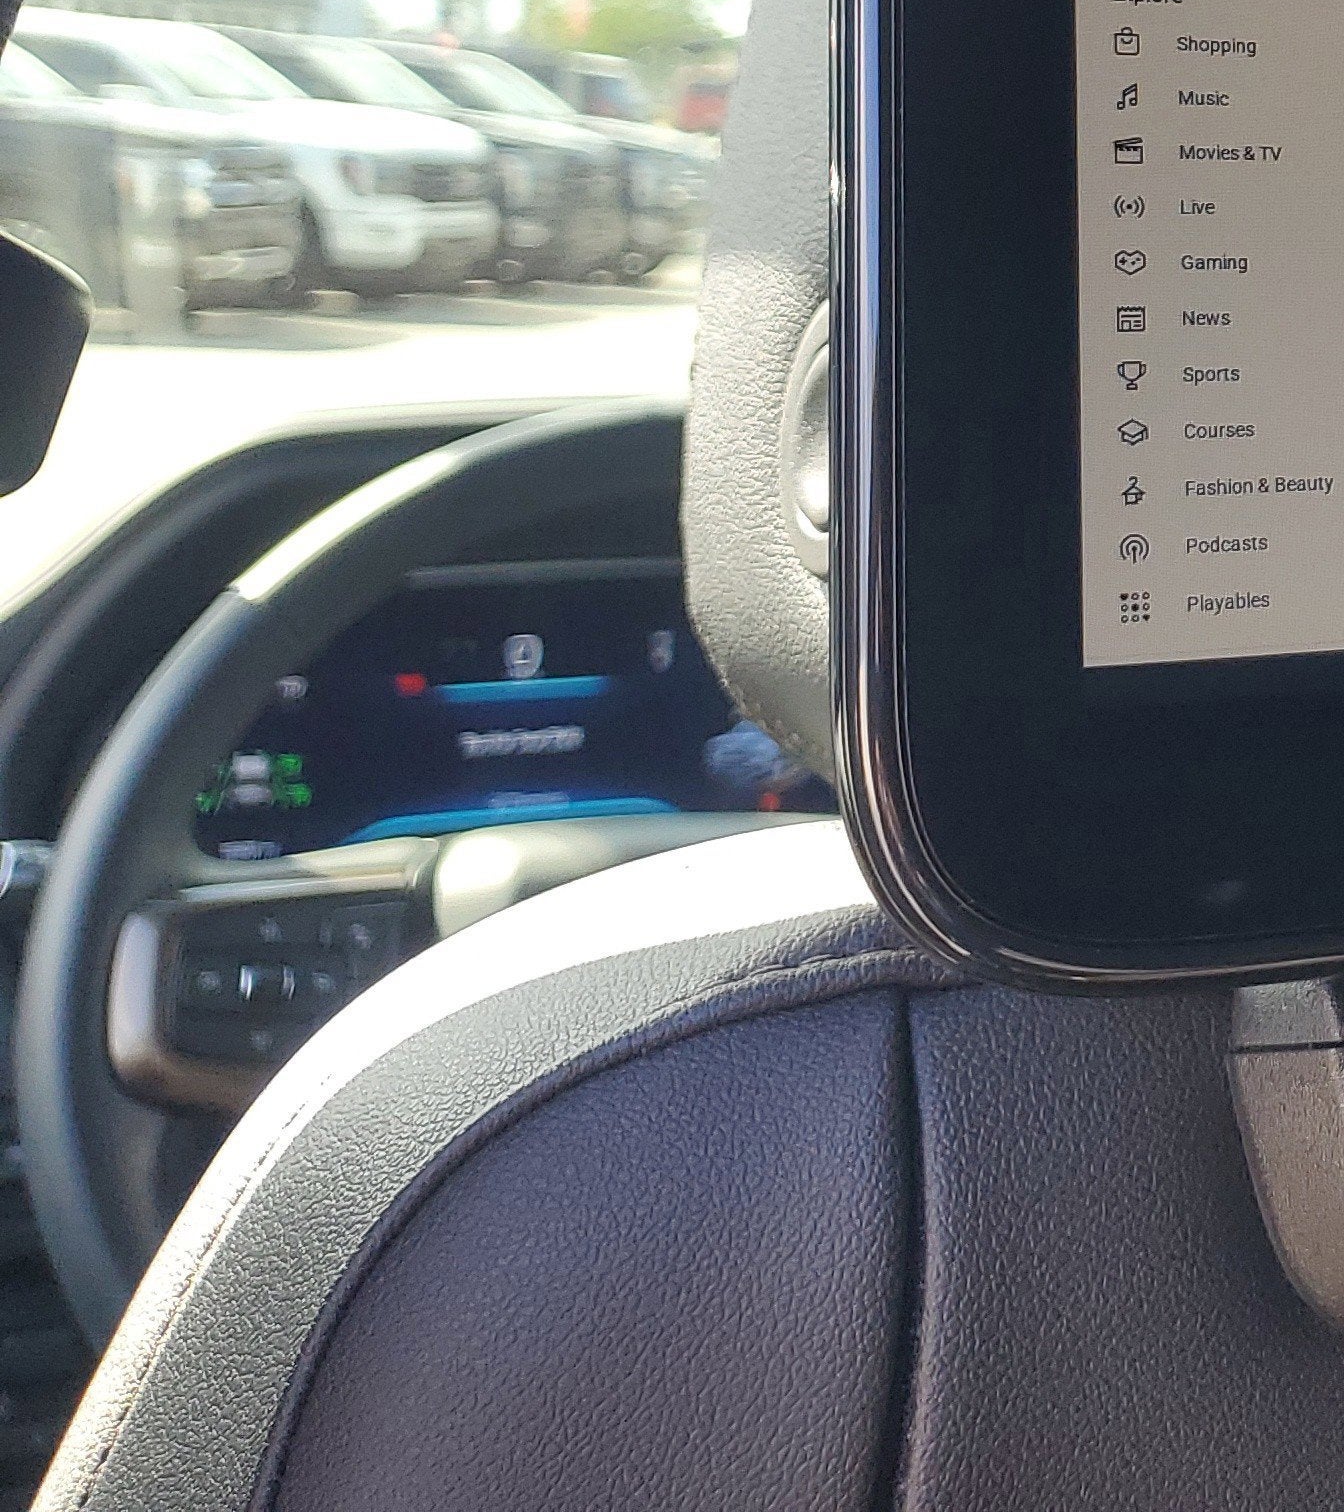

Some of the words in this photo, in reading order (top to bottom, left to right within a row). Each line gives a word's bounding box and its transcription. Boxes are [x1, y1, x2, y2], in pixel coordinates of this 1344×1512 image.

[1176, 35, 1257, 57] Shopping
[1178, 89, 1230, 107] Music
[1179, 144, 1239, 162] Movies
[1243, 145, 1256, 161] &
[1259, 146, 1283, 162] TV
[1179, 199, 1216, 216] Live
[1181, 253, 1249, 274] Gaming
[1182, 310, 1232, 327] News
[1182, 366, 1241, 385] Sports
[1184, 422, 1256, 439] Courses
[1185, 477, 1254, 497] Fashion
[1257, 477, 1270, 493] &
[1275, 475, 1334, 494] Beauty
[1186, 535, 1269, 555] Podcasts
[1187, 592, 1271, 615] Playables
